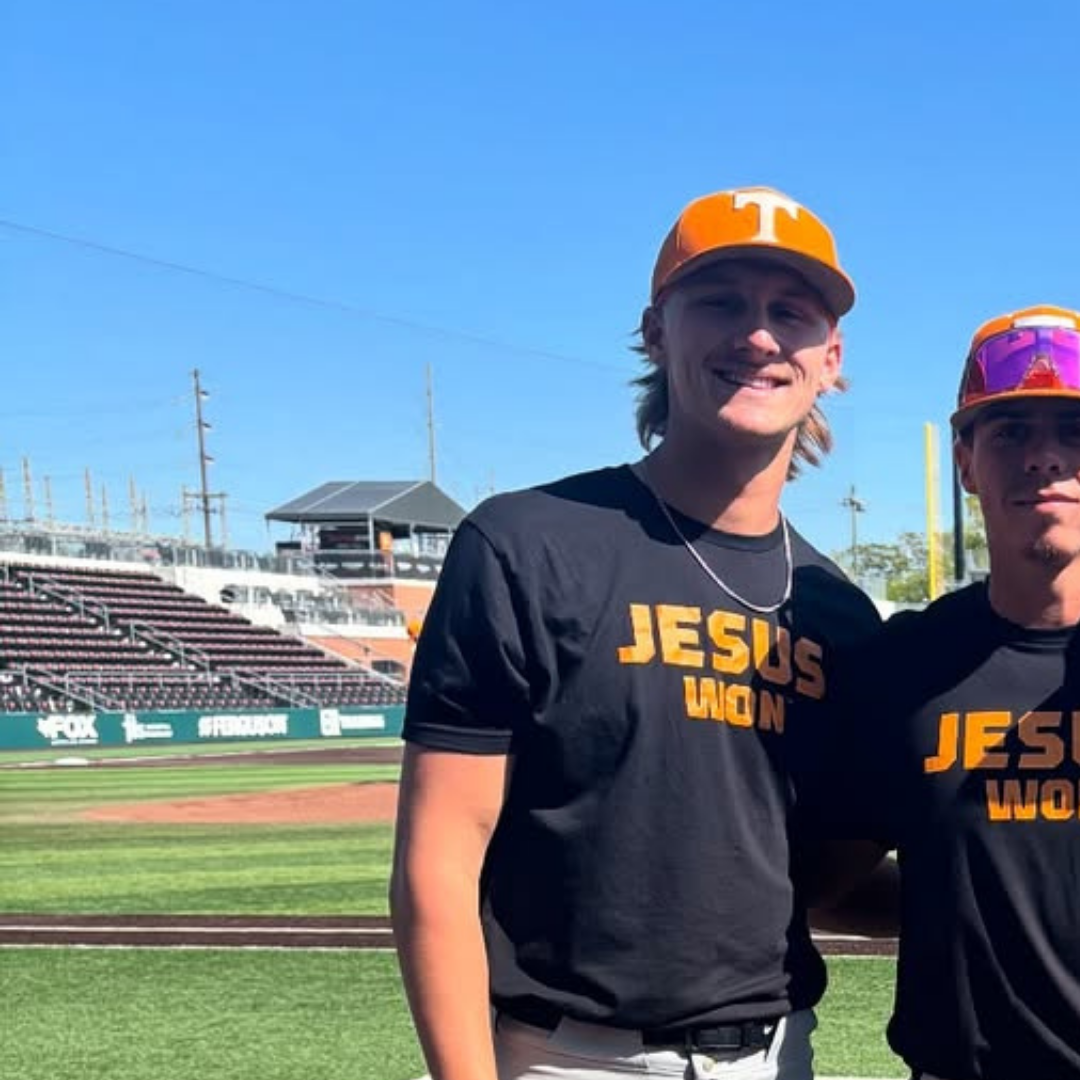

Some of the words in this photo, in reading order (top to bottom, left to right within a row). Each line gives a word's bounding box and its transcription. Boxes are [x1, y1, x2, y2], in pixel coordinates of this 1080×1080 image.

[733, 190, 799, 243] T
[617, 603, 826, 699] JESUS
[683, 675, 785, 734] WON
